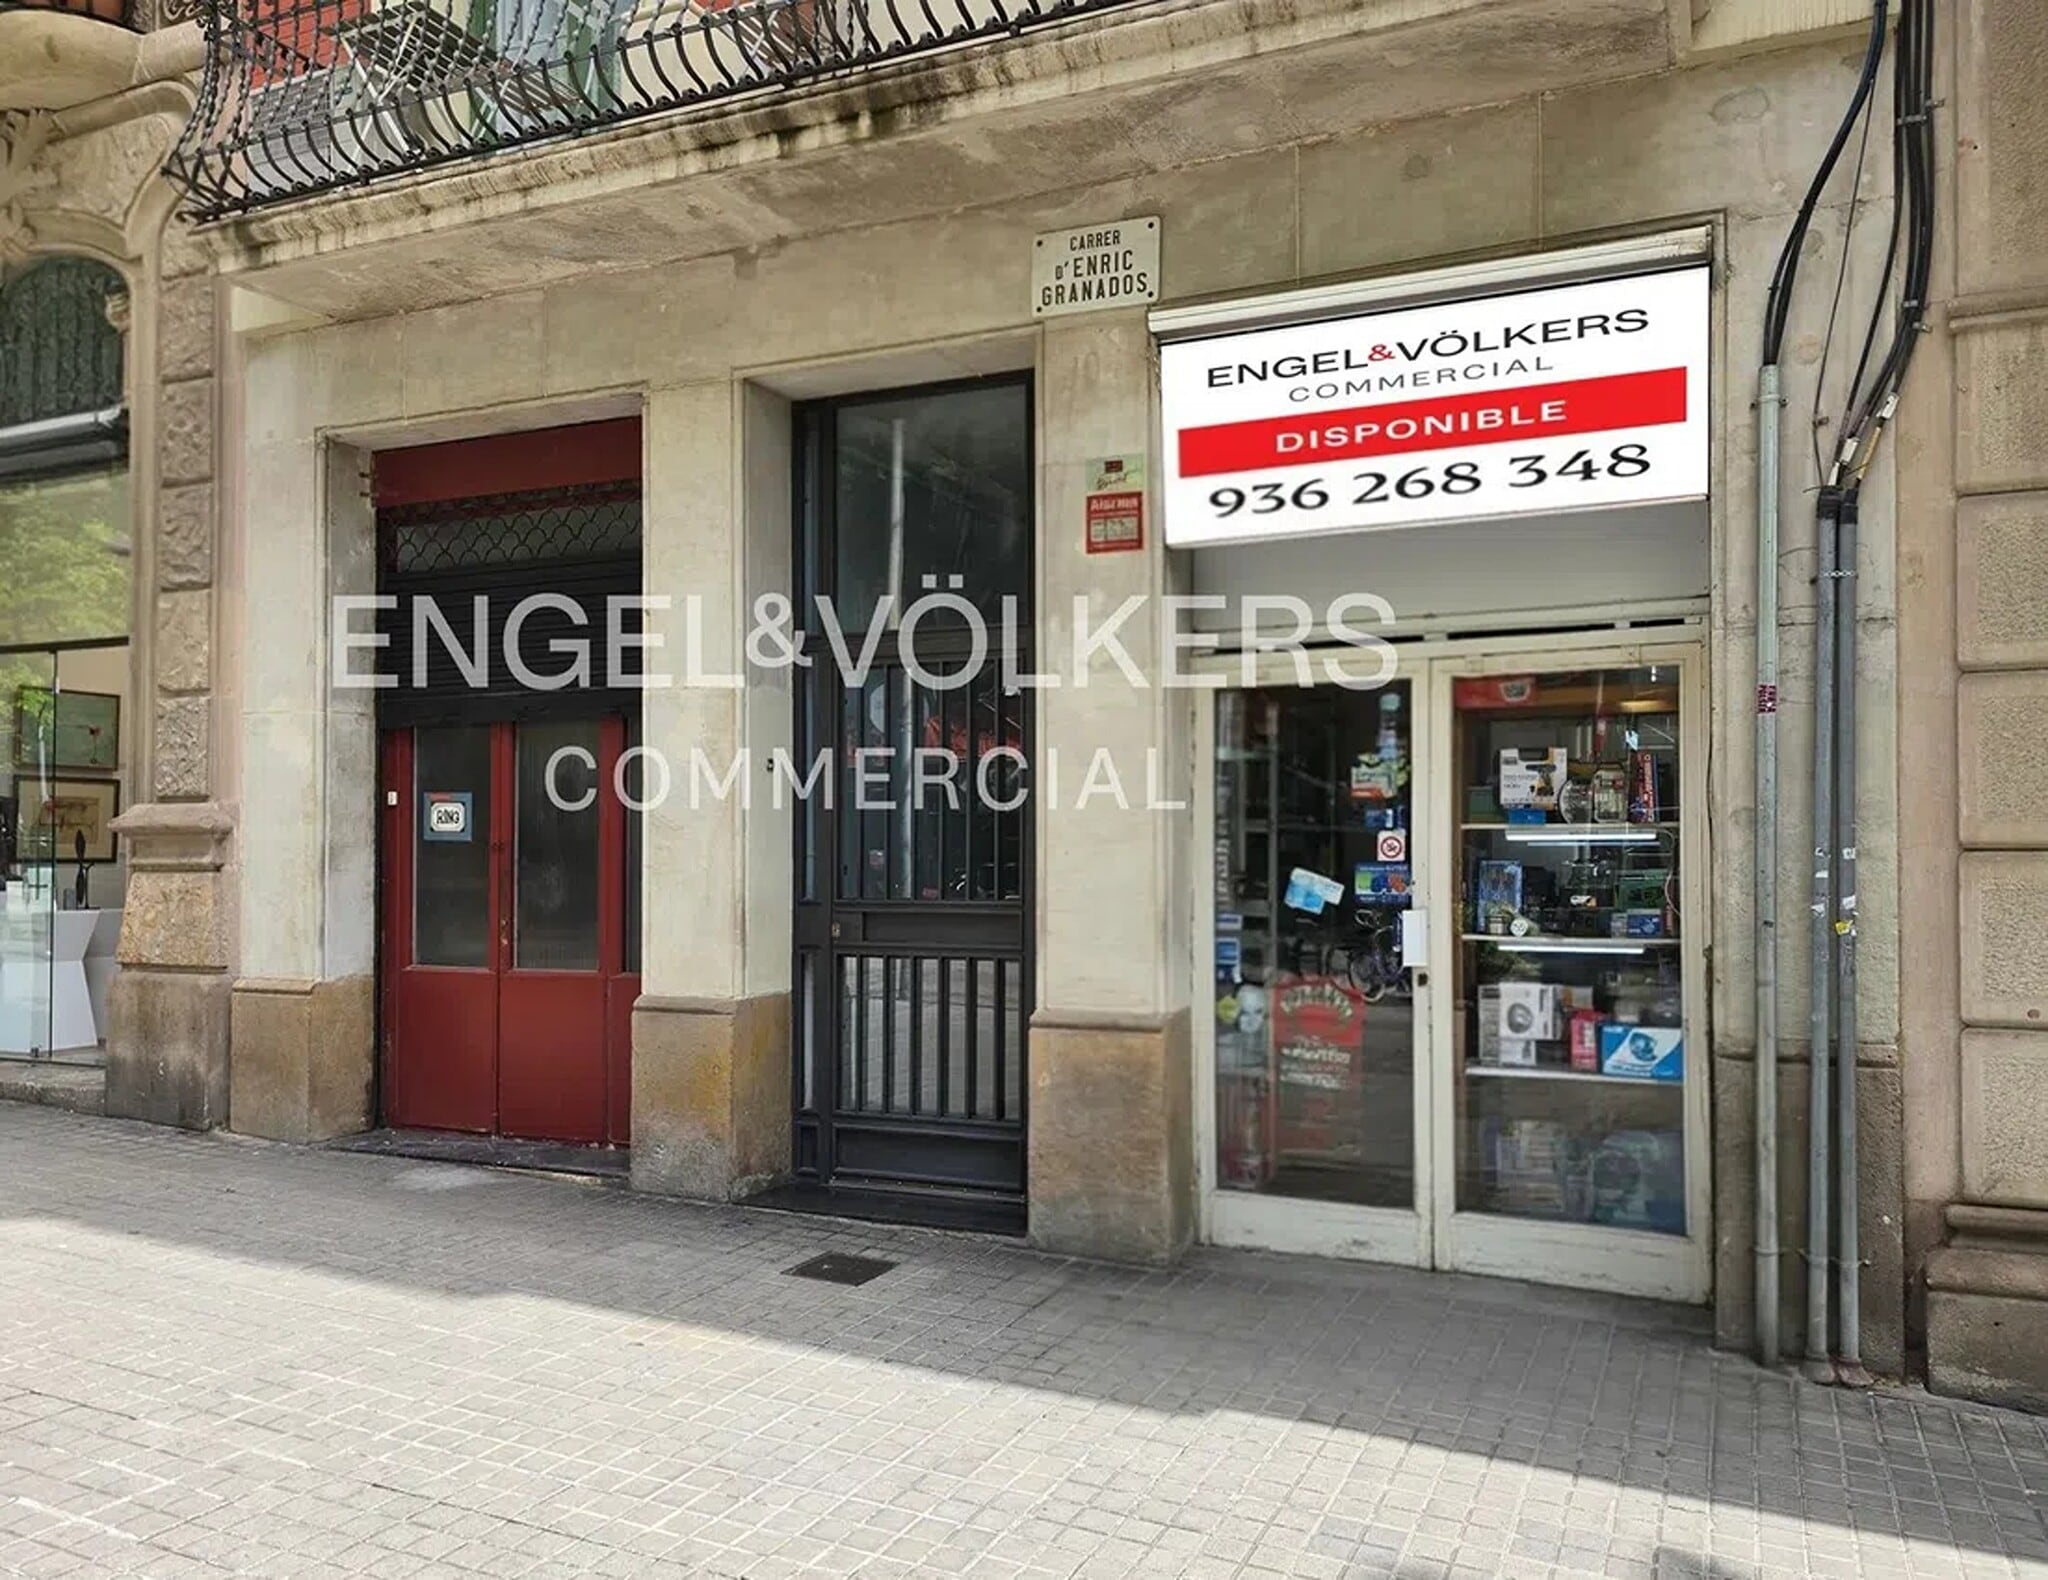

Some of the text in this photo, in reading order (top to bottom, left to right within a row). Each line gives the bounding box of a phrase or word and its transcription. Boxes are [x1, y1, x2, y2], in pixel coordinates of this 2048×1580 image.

[1069, 229, 1121, 251] CARRER
[1042, 272, 1147, 306] GRANADOS
[1208, 309, 1649, 388] ENGEL&VÖLKERS
[1289, 355, 1553, 403] COMMERCIAL
[1275, 401, 1567, 453] DISPONIBLE
[1209, 444, 1651, 518] 936 268 348
